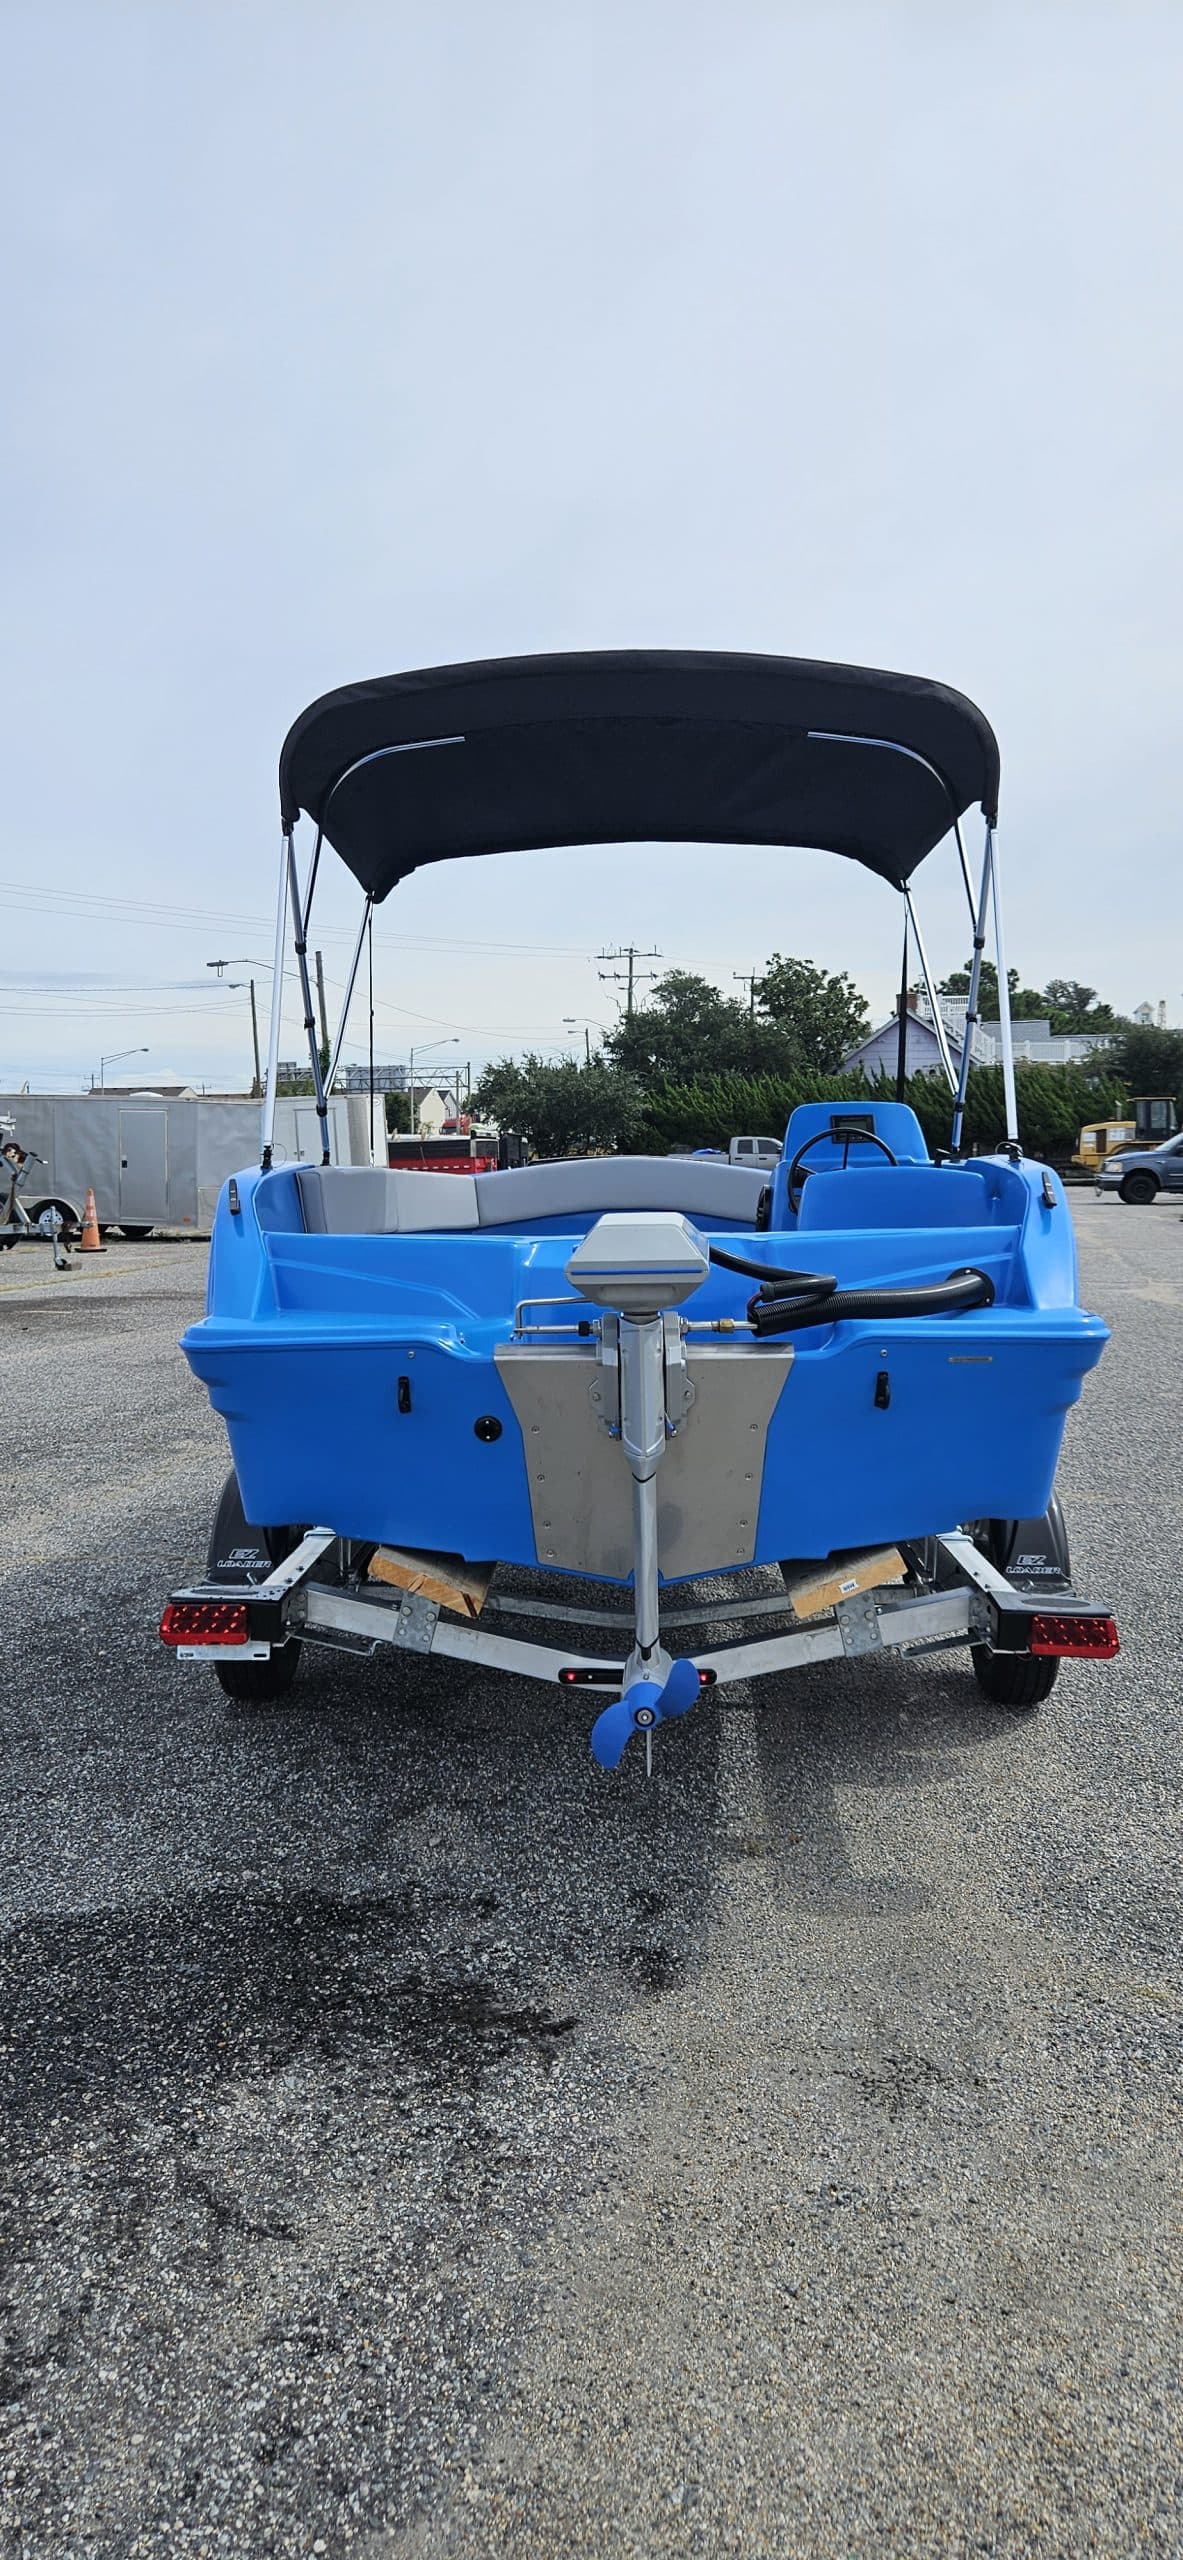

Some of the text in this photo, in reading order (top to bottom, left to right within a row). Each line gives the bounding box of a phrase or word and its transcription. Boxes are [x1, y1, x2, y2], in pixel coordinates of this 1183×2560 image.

[229, 1549, 259, 1559] EZ
[217, 1560, 271, 1568] LOADER
[1016, 1555, 1047, 1565] EZ
[1006, 1566, 1061, 1574] LOADER
